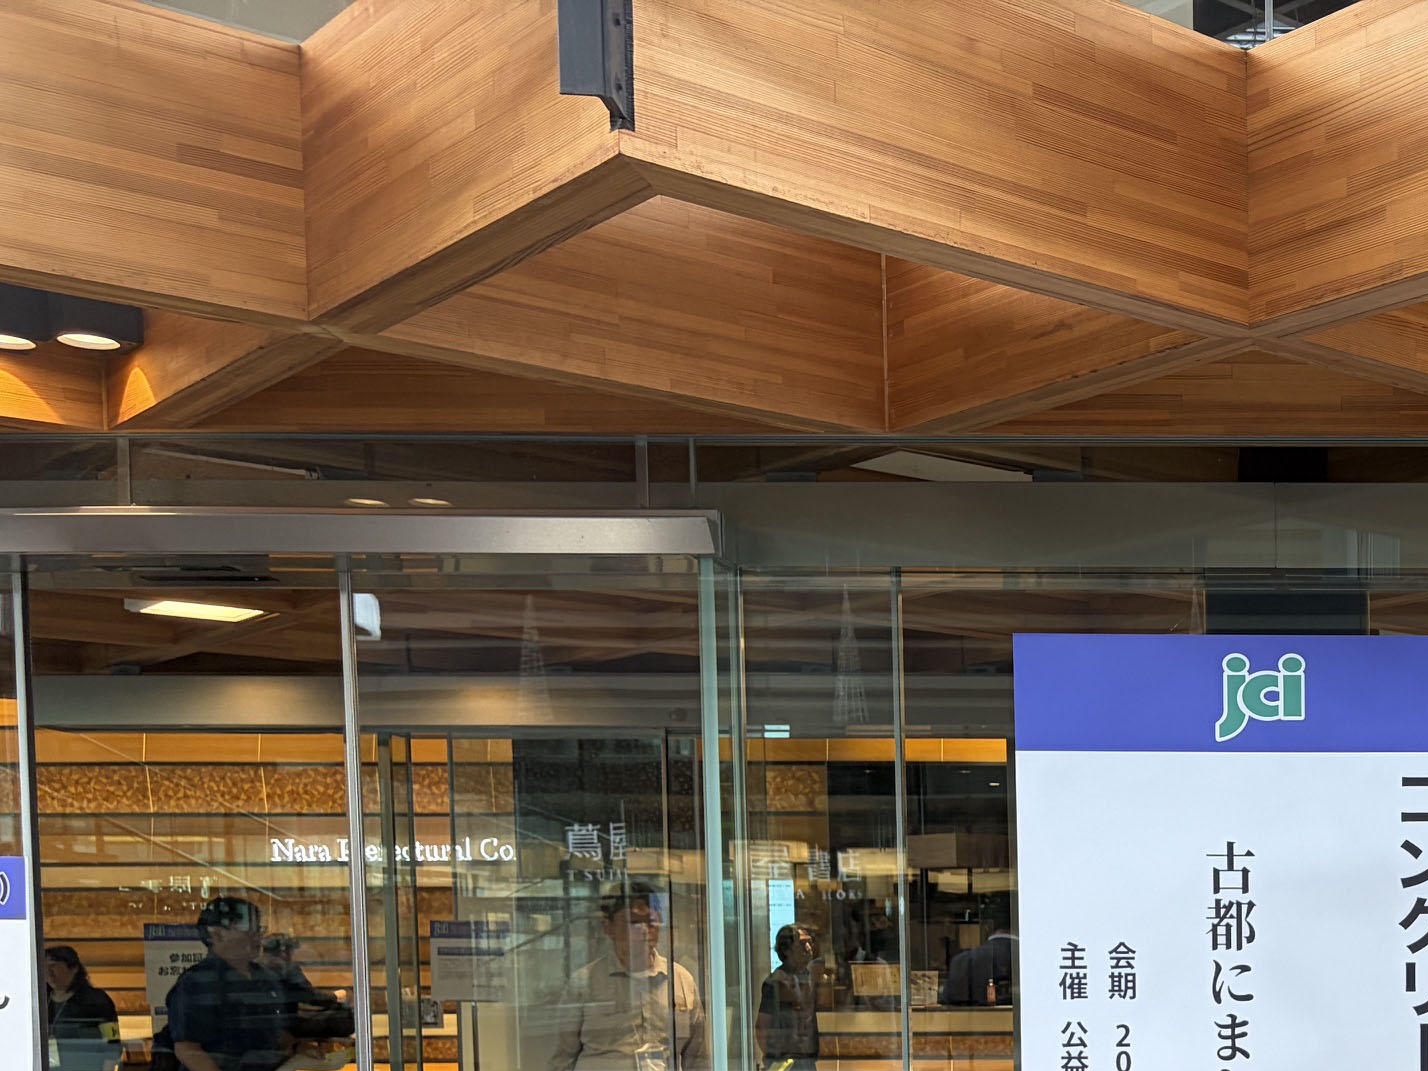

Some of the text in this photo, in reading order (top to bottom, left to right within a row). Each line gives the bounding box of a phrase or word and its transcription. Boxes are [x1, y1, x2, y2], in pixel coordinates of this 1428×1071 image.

[1215, 653, 1306, 742] jci
[270, 838, 332, 862] Nara
[1058, 941, 1089, 1000] 主催
[1108, 941, 1137, 1000] 会期
